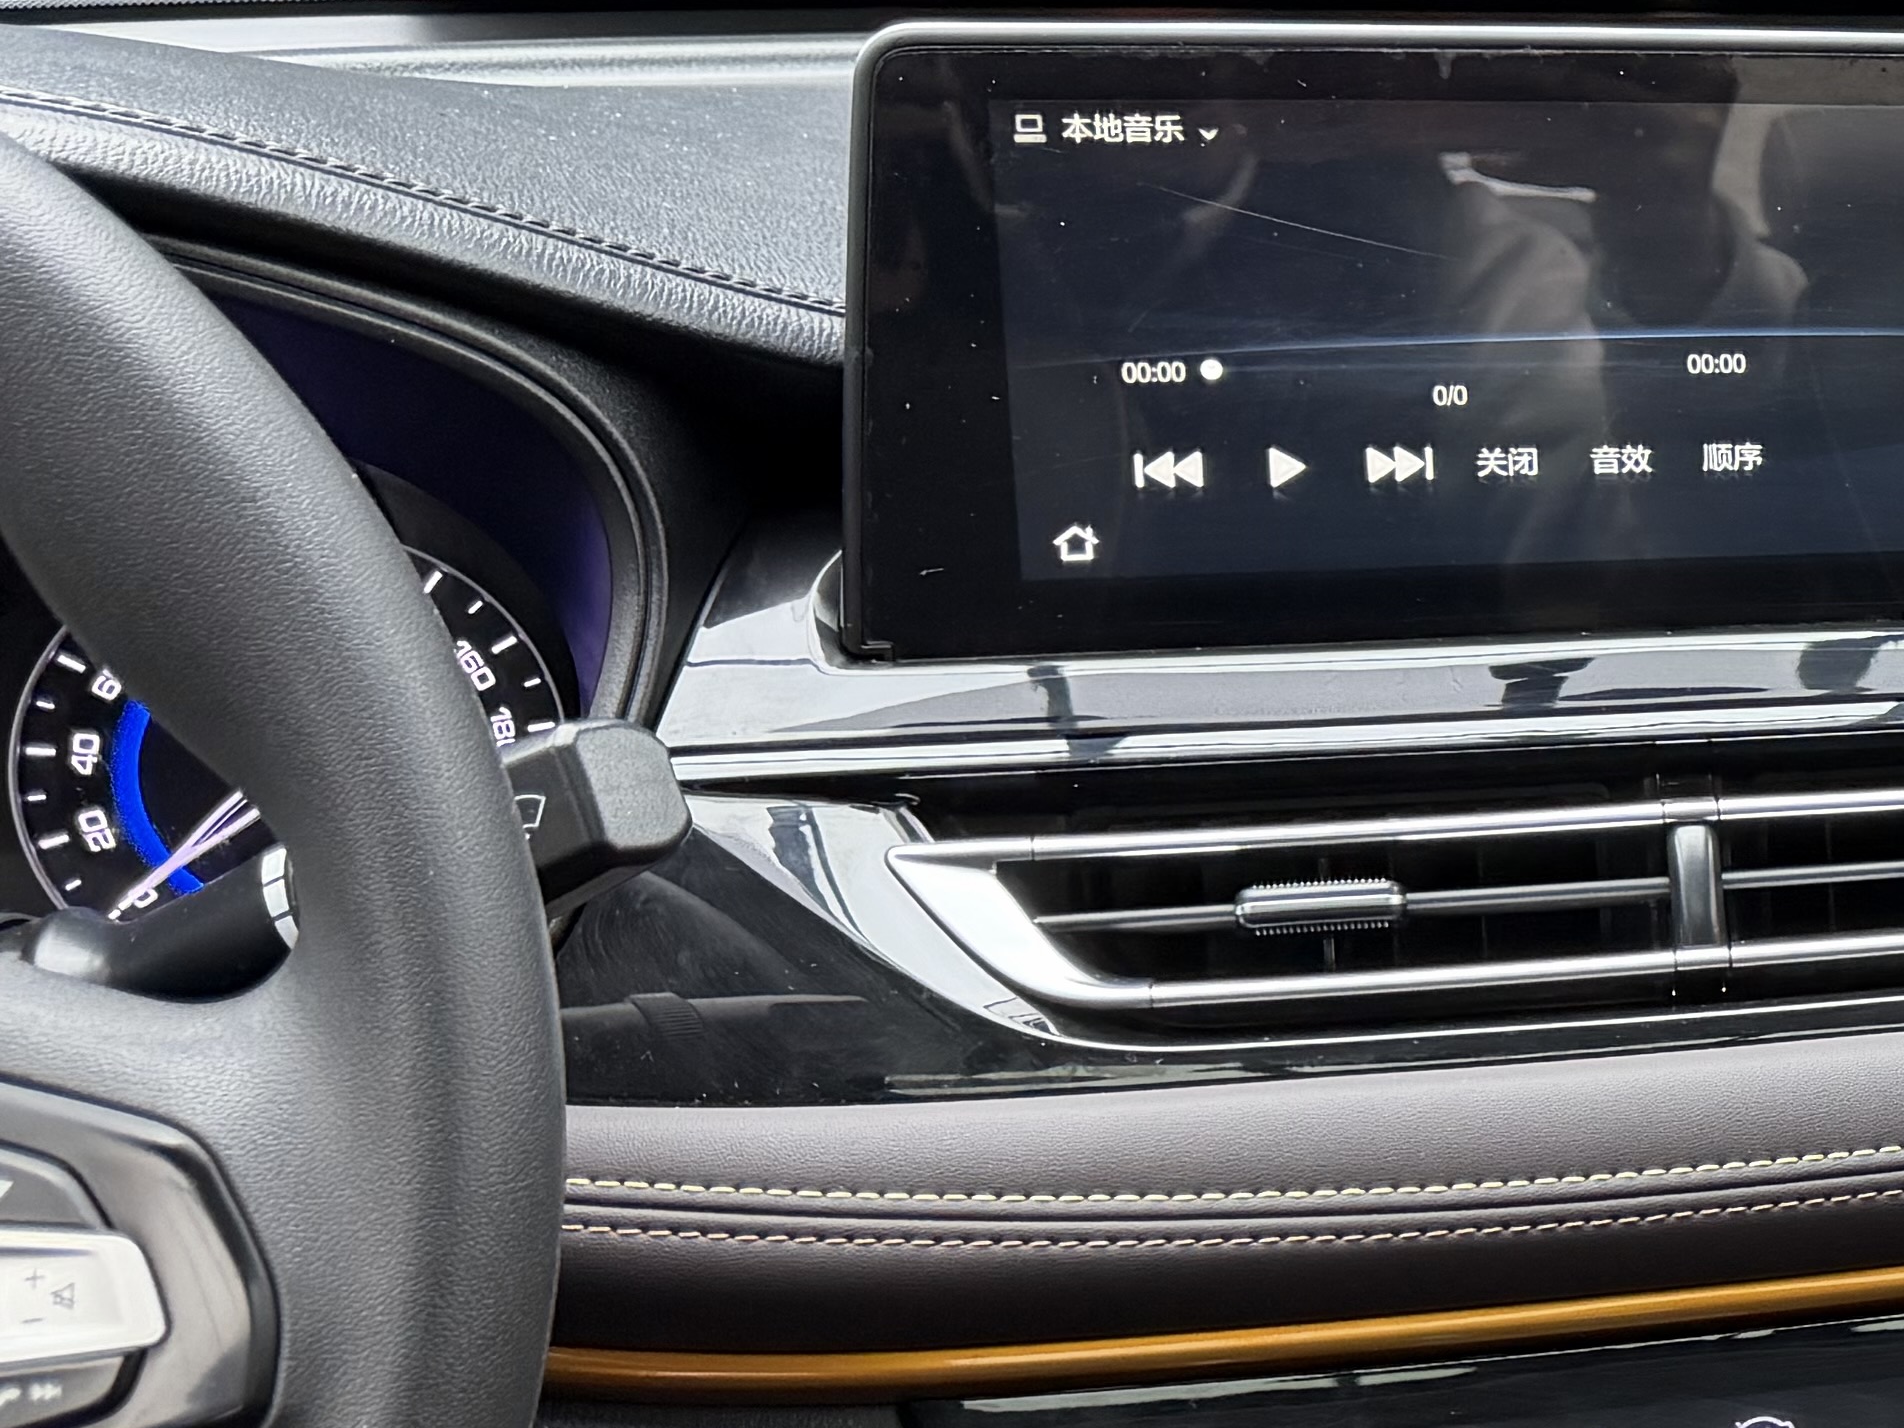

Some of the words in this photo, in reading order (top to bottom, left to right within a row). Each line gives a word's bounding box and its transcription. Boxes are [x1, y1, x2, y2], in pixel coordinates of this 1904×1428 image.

[1062, 112, 1185, 144] 本地音乐
[1121, 361, 1187, 384] 00:00
[1686, 353, 1747, 374] 00:00
[1432, 384, 1468, 406] 0/0
[1476, 447, 1539, 477] 关闭
[1590, 444, 1654, 475] 音效
[1702, 442, 1764, 472] 顺序
[454, 640, 496, 691] 160
[91, 664, 122, 701] 6
[490, 706, 516, 748] 18
[70, 732, 101, 776] 40
[77, 809, 117, 853] 20
